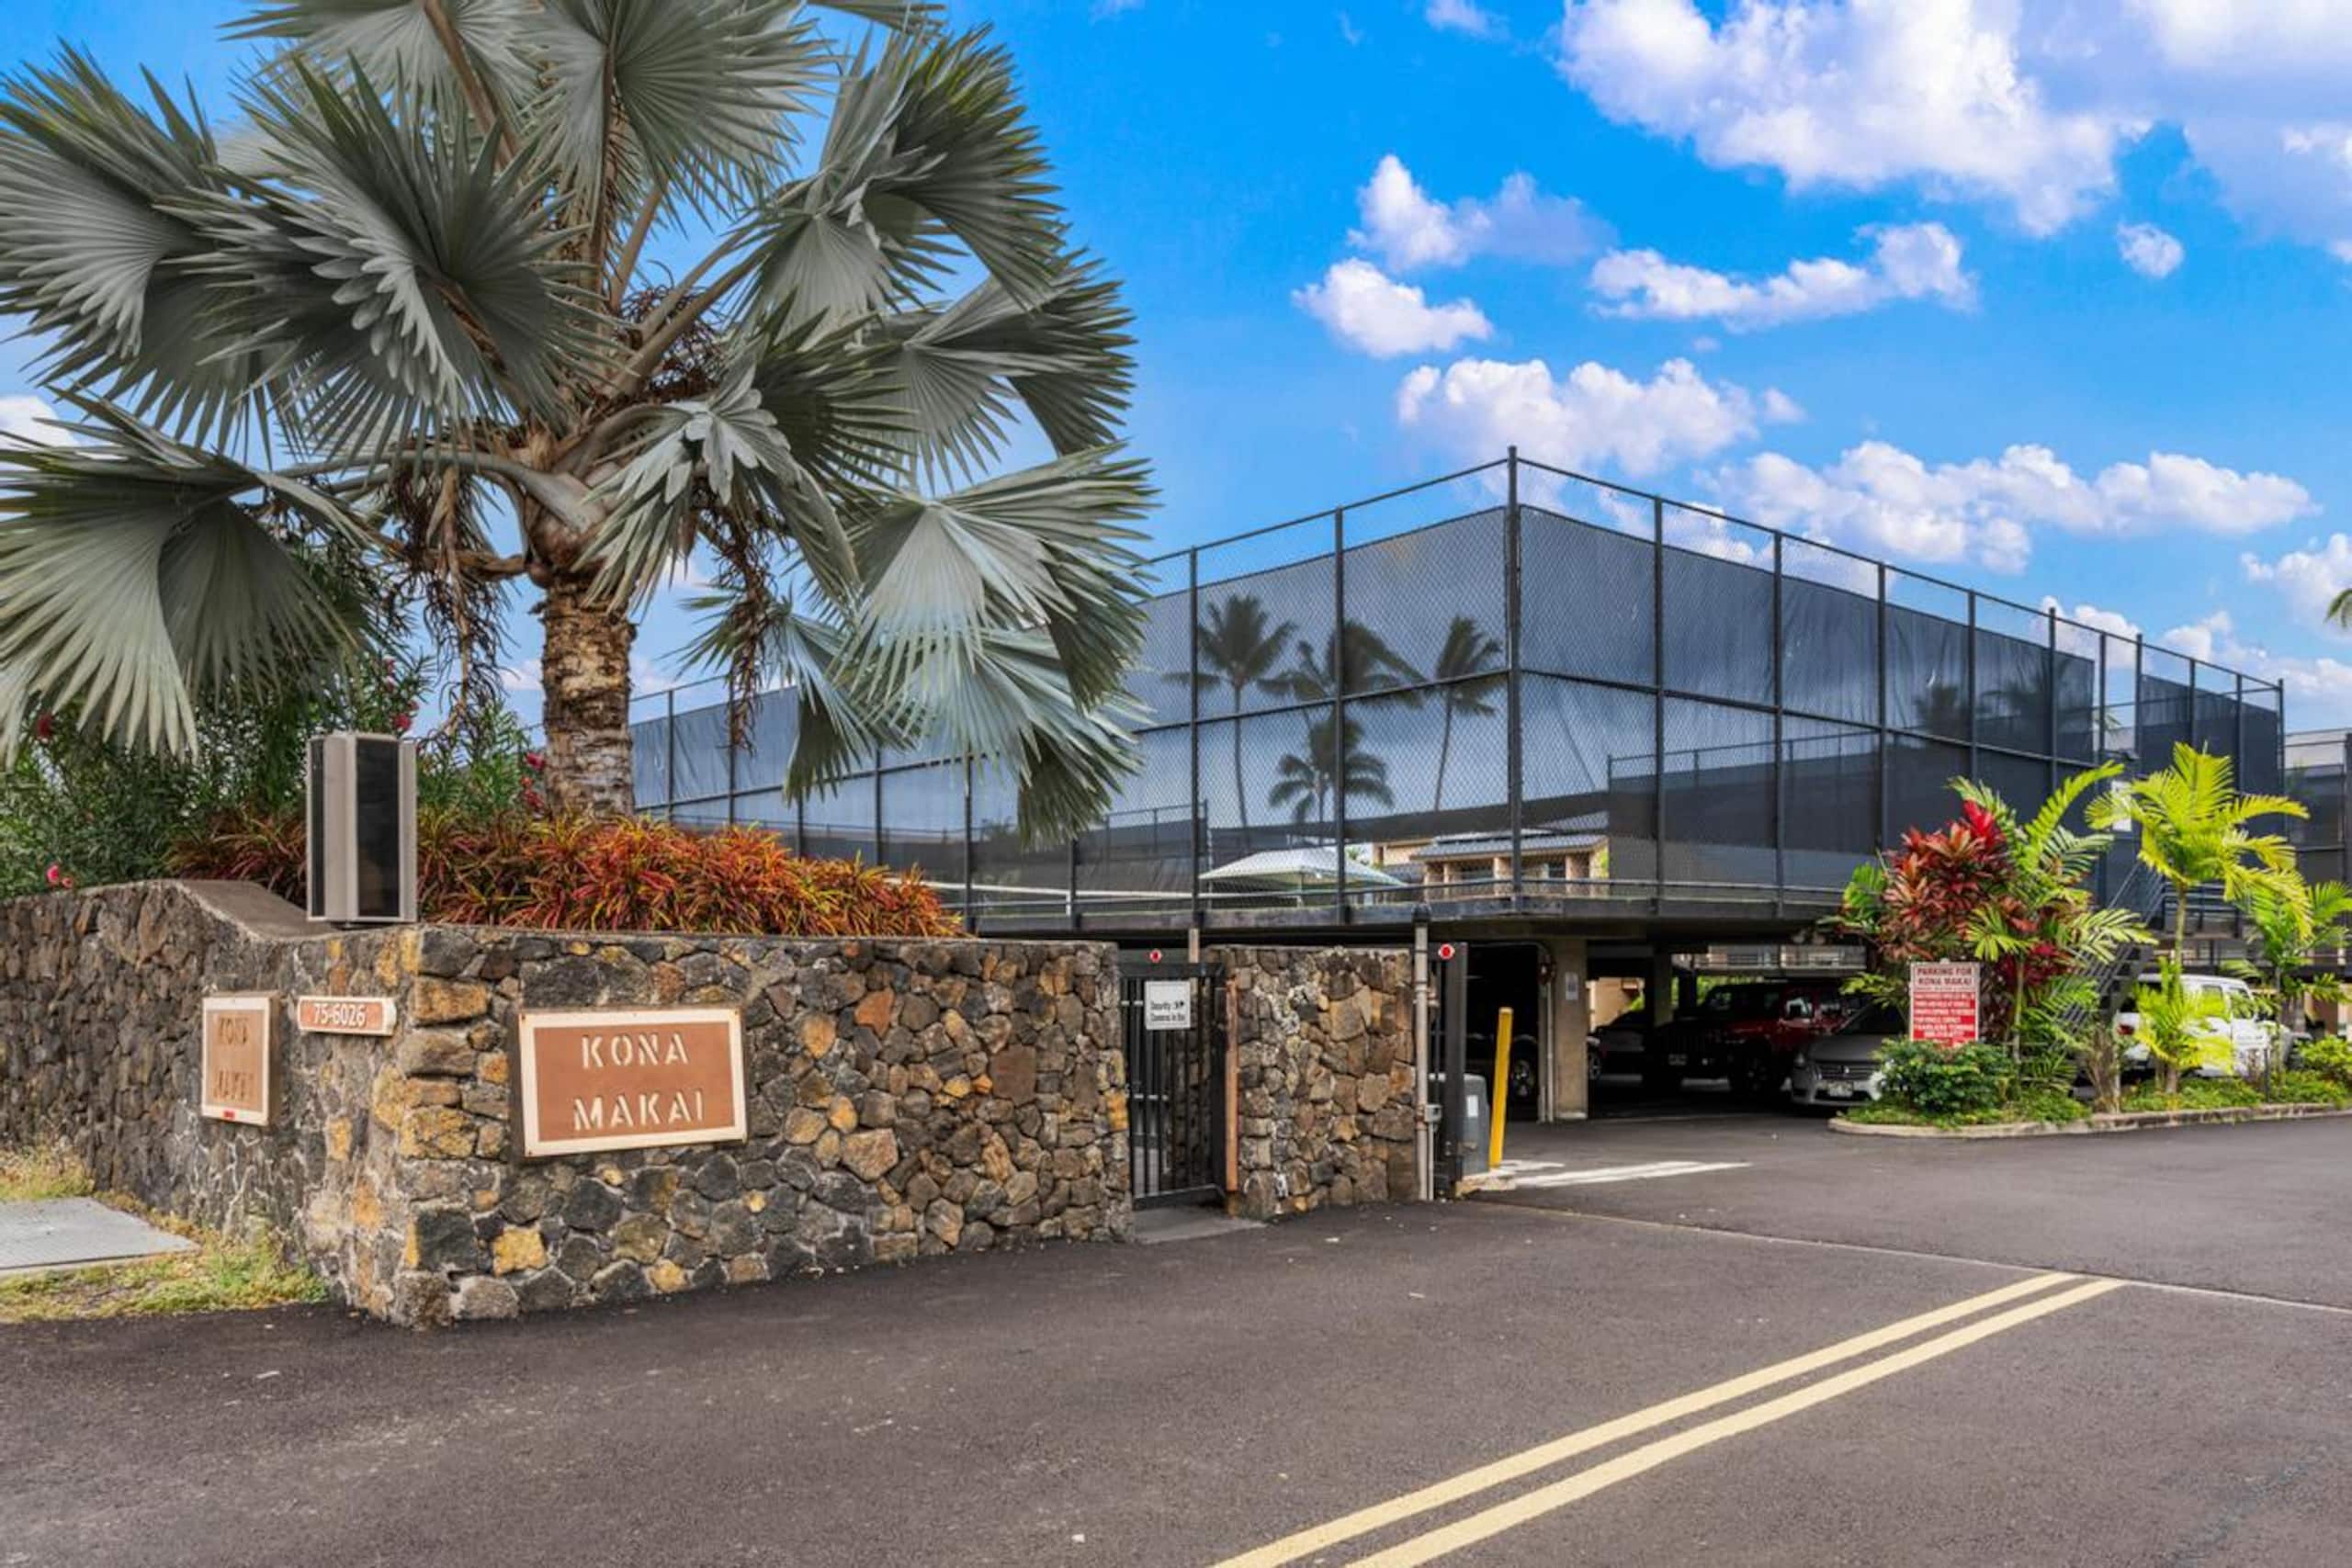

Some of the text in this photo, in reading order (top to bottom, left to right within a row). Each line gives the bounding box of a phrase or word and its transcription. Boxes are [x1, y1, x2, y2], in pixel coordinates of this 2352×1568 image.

[313, 1004, 366, 1027] 75-6026
[582, 1033, 689, 1069] KONA
[573, 1090, 703, 1132] MAKAI
